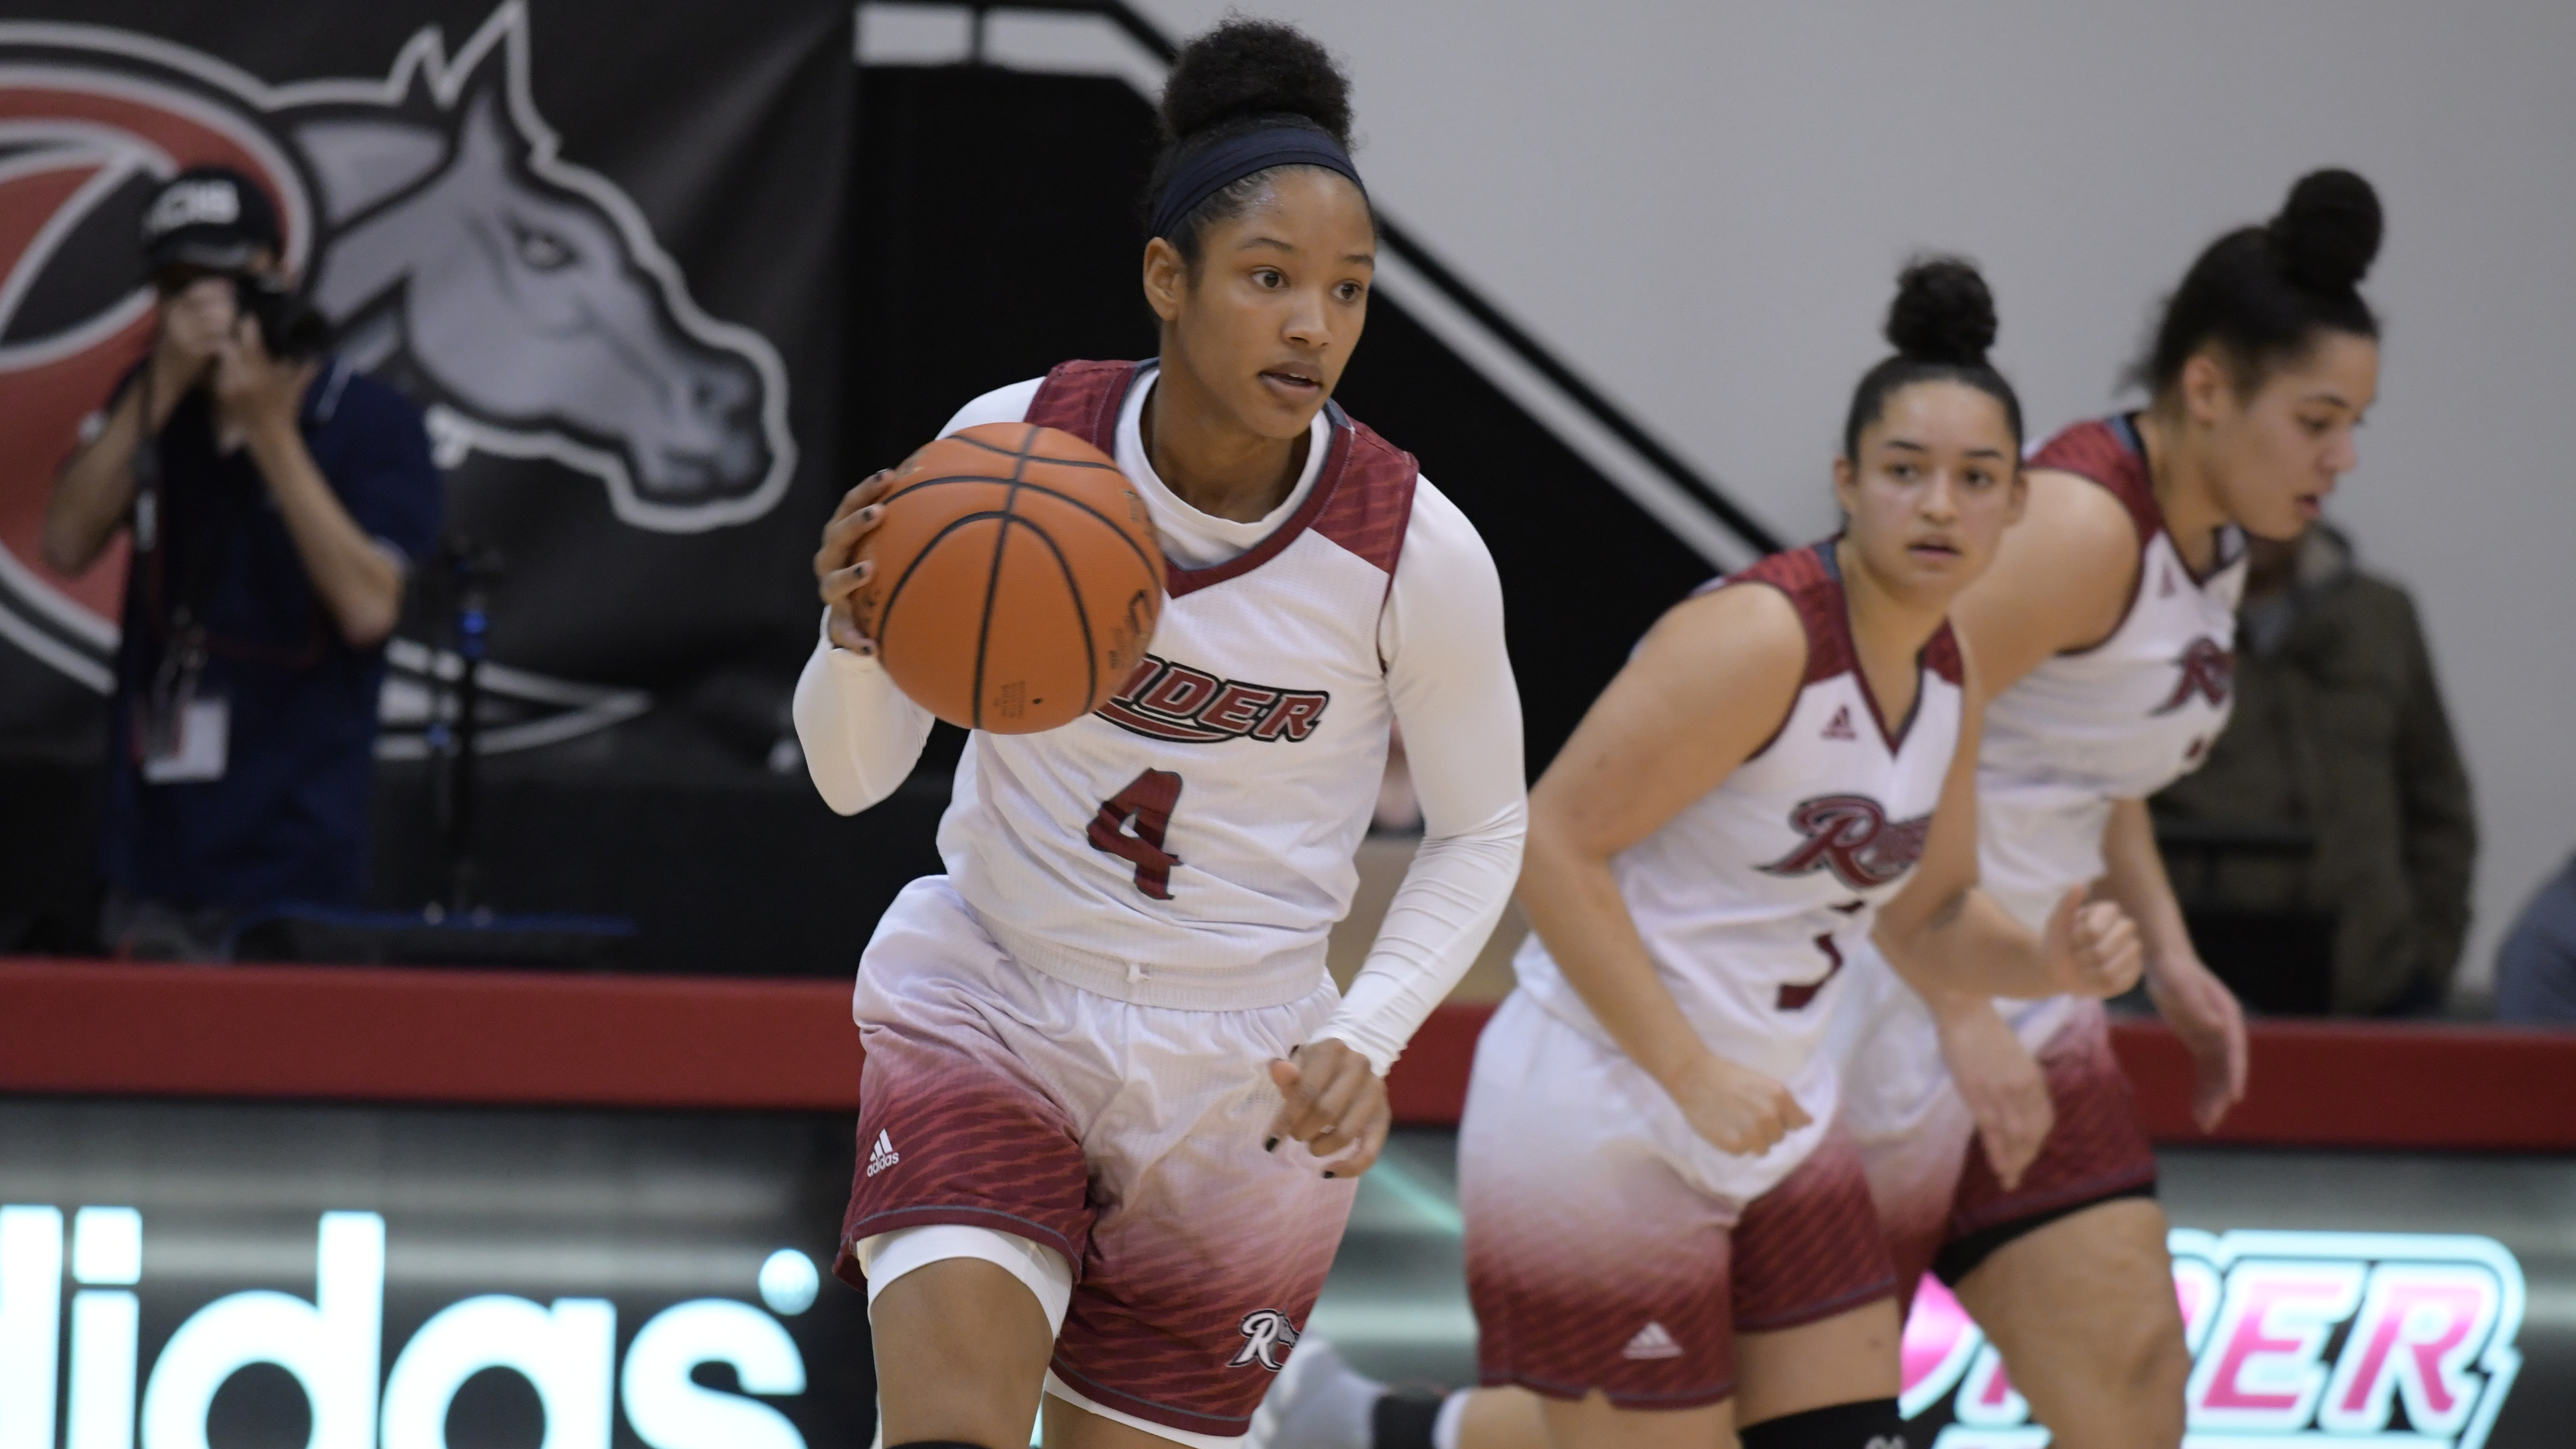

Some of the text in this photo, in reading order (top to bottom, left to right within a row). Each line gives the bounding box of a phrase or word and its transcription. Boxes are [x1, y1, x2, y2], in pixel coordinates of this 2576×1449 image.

[1093, 653, 1330, 743] IDER
[1086, 767, 1183, 900] 4
[867, 1152, 900, 1177] adidas
[0, 1205, 807, 1449] idas
